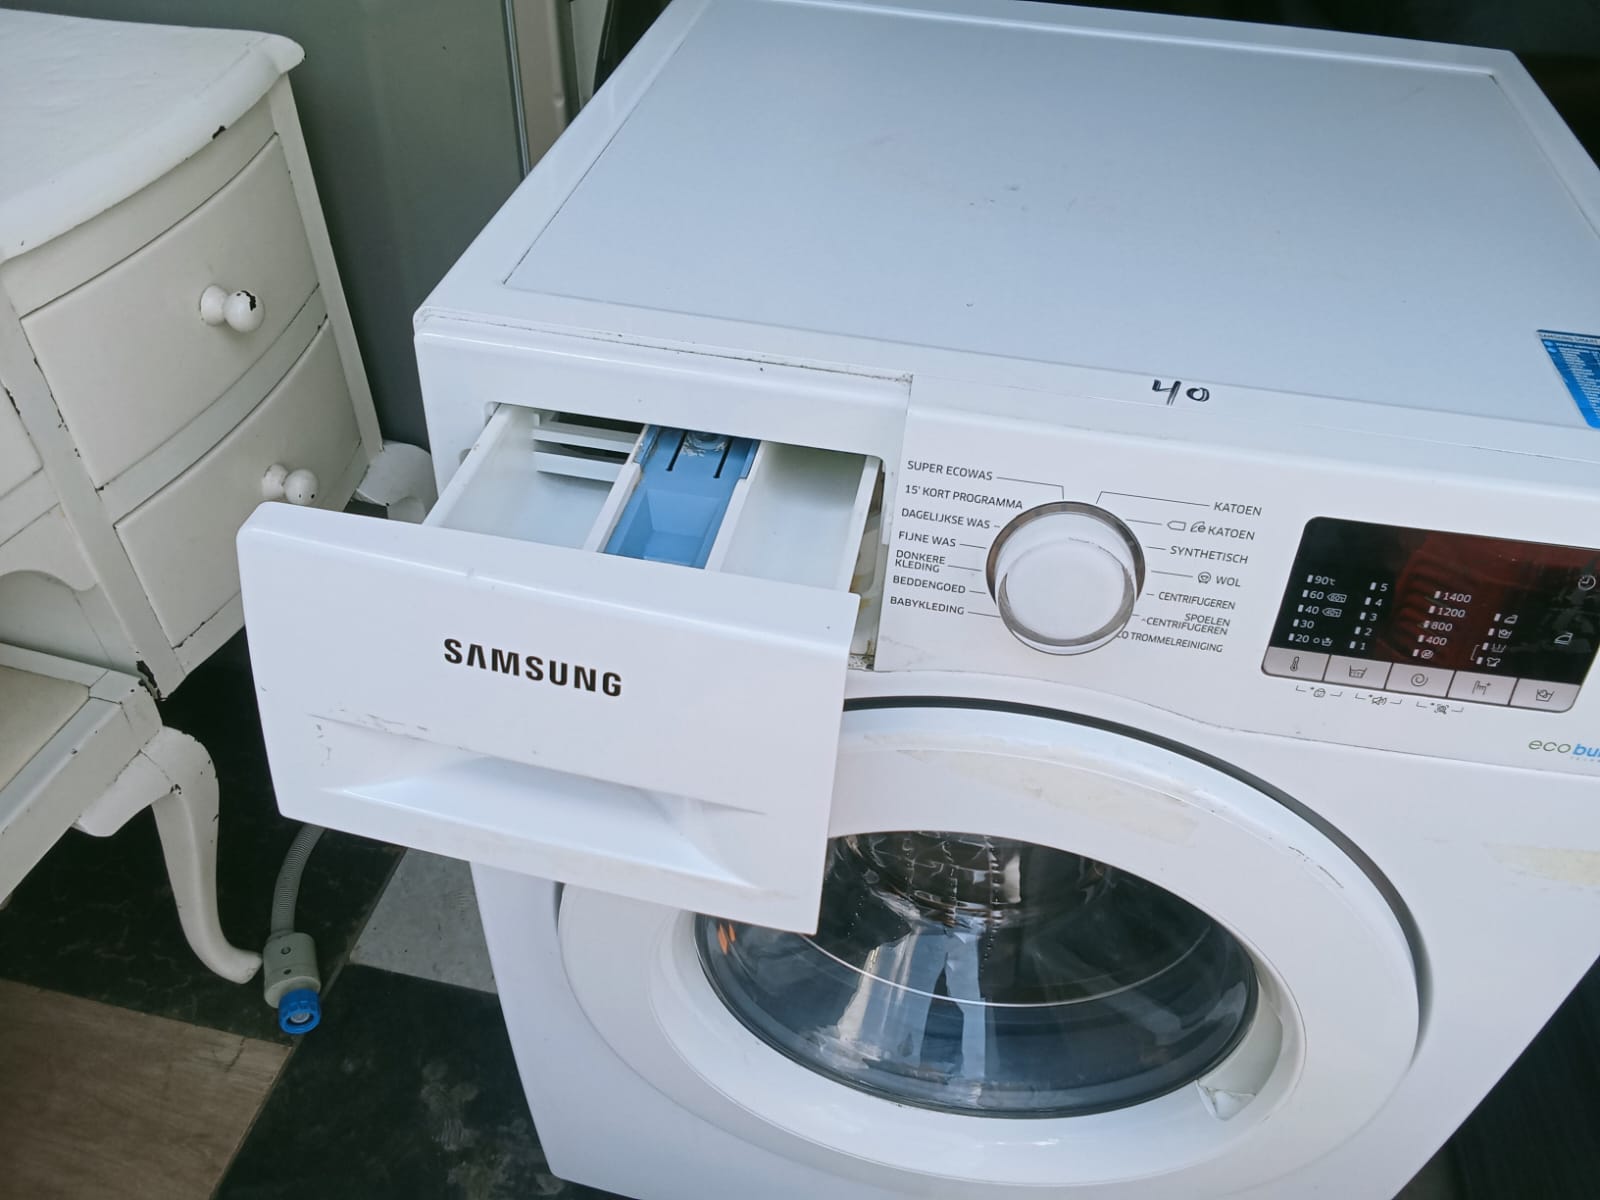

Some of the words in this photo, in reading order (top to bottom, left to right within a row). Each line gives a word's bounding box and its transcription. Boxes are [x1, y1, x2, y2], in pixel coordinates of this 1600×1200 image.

[1152, 379, 1210, 406] 40
[907, 460, 943, 475] SUPER
[946, 466, 993, 481] ECOWAS
[905, 484, 921, 494] 15'
[922, 487, 951, 499] KORT
[952, 491, 1023, 509] PROGRAMMA
[1213, 501, 1262, 516] KATOEN
[901, 508, 964, 525] DAGELIJKSE
[966, 518, 991, 529] WAS
[898, 531, 929, 543] FIJNE
[932, 536, 956, 547] WAS
[1208, 526, 1255, 541] KATOEN
[896, 550, 946, 564] DONKERE
[1170, 545, 1249, 564] SYNTHETISCH
[895, 560, 940, 573] KLEDING
[893, 575, 966, 593] BEDDENGOED
[1216, 575, 1241, 587] WOL
[1380, 583, 1388, 592] 5
[1158, 591, 1236, 610] CENTRIFUGEREN
[1309, 591, 1324, 600] 60
[1443, 592, 1472, 603] 1400
[890, 596, 965, 615] BABYKLEDING
[1375, 598, 1383, 607] 4
[1305, 605, 1319, 615] 40
[1438, 607, 1466, 618] 1200
[1184, 613, 1230, 627] SPOELEN
[1369, 613, 1378, 621] 3
[1300, 620, 1315, 629] 30
[1431, 622, 1453, 632] 800
[1295, 634, 1310, 643] 20
[1364, 628, 1373, 637] 2
[1131, 632, 1223, 653] TROMMELREINIGING
[1360, 642, 1366, 651] 1
[1426, 636, 1448, 646] 400
[444, 638, 622, 697] SAMSUNG
